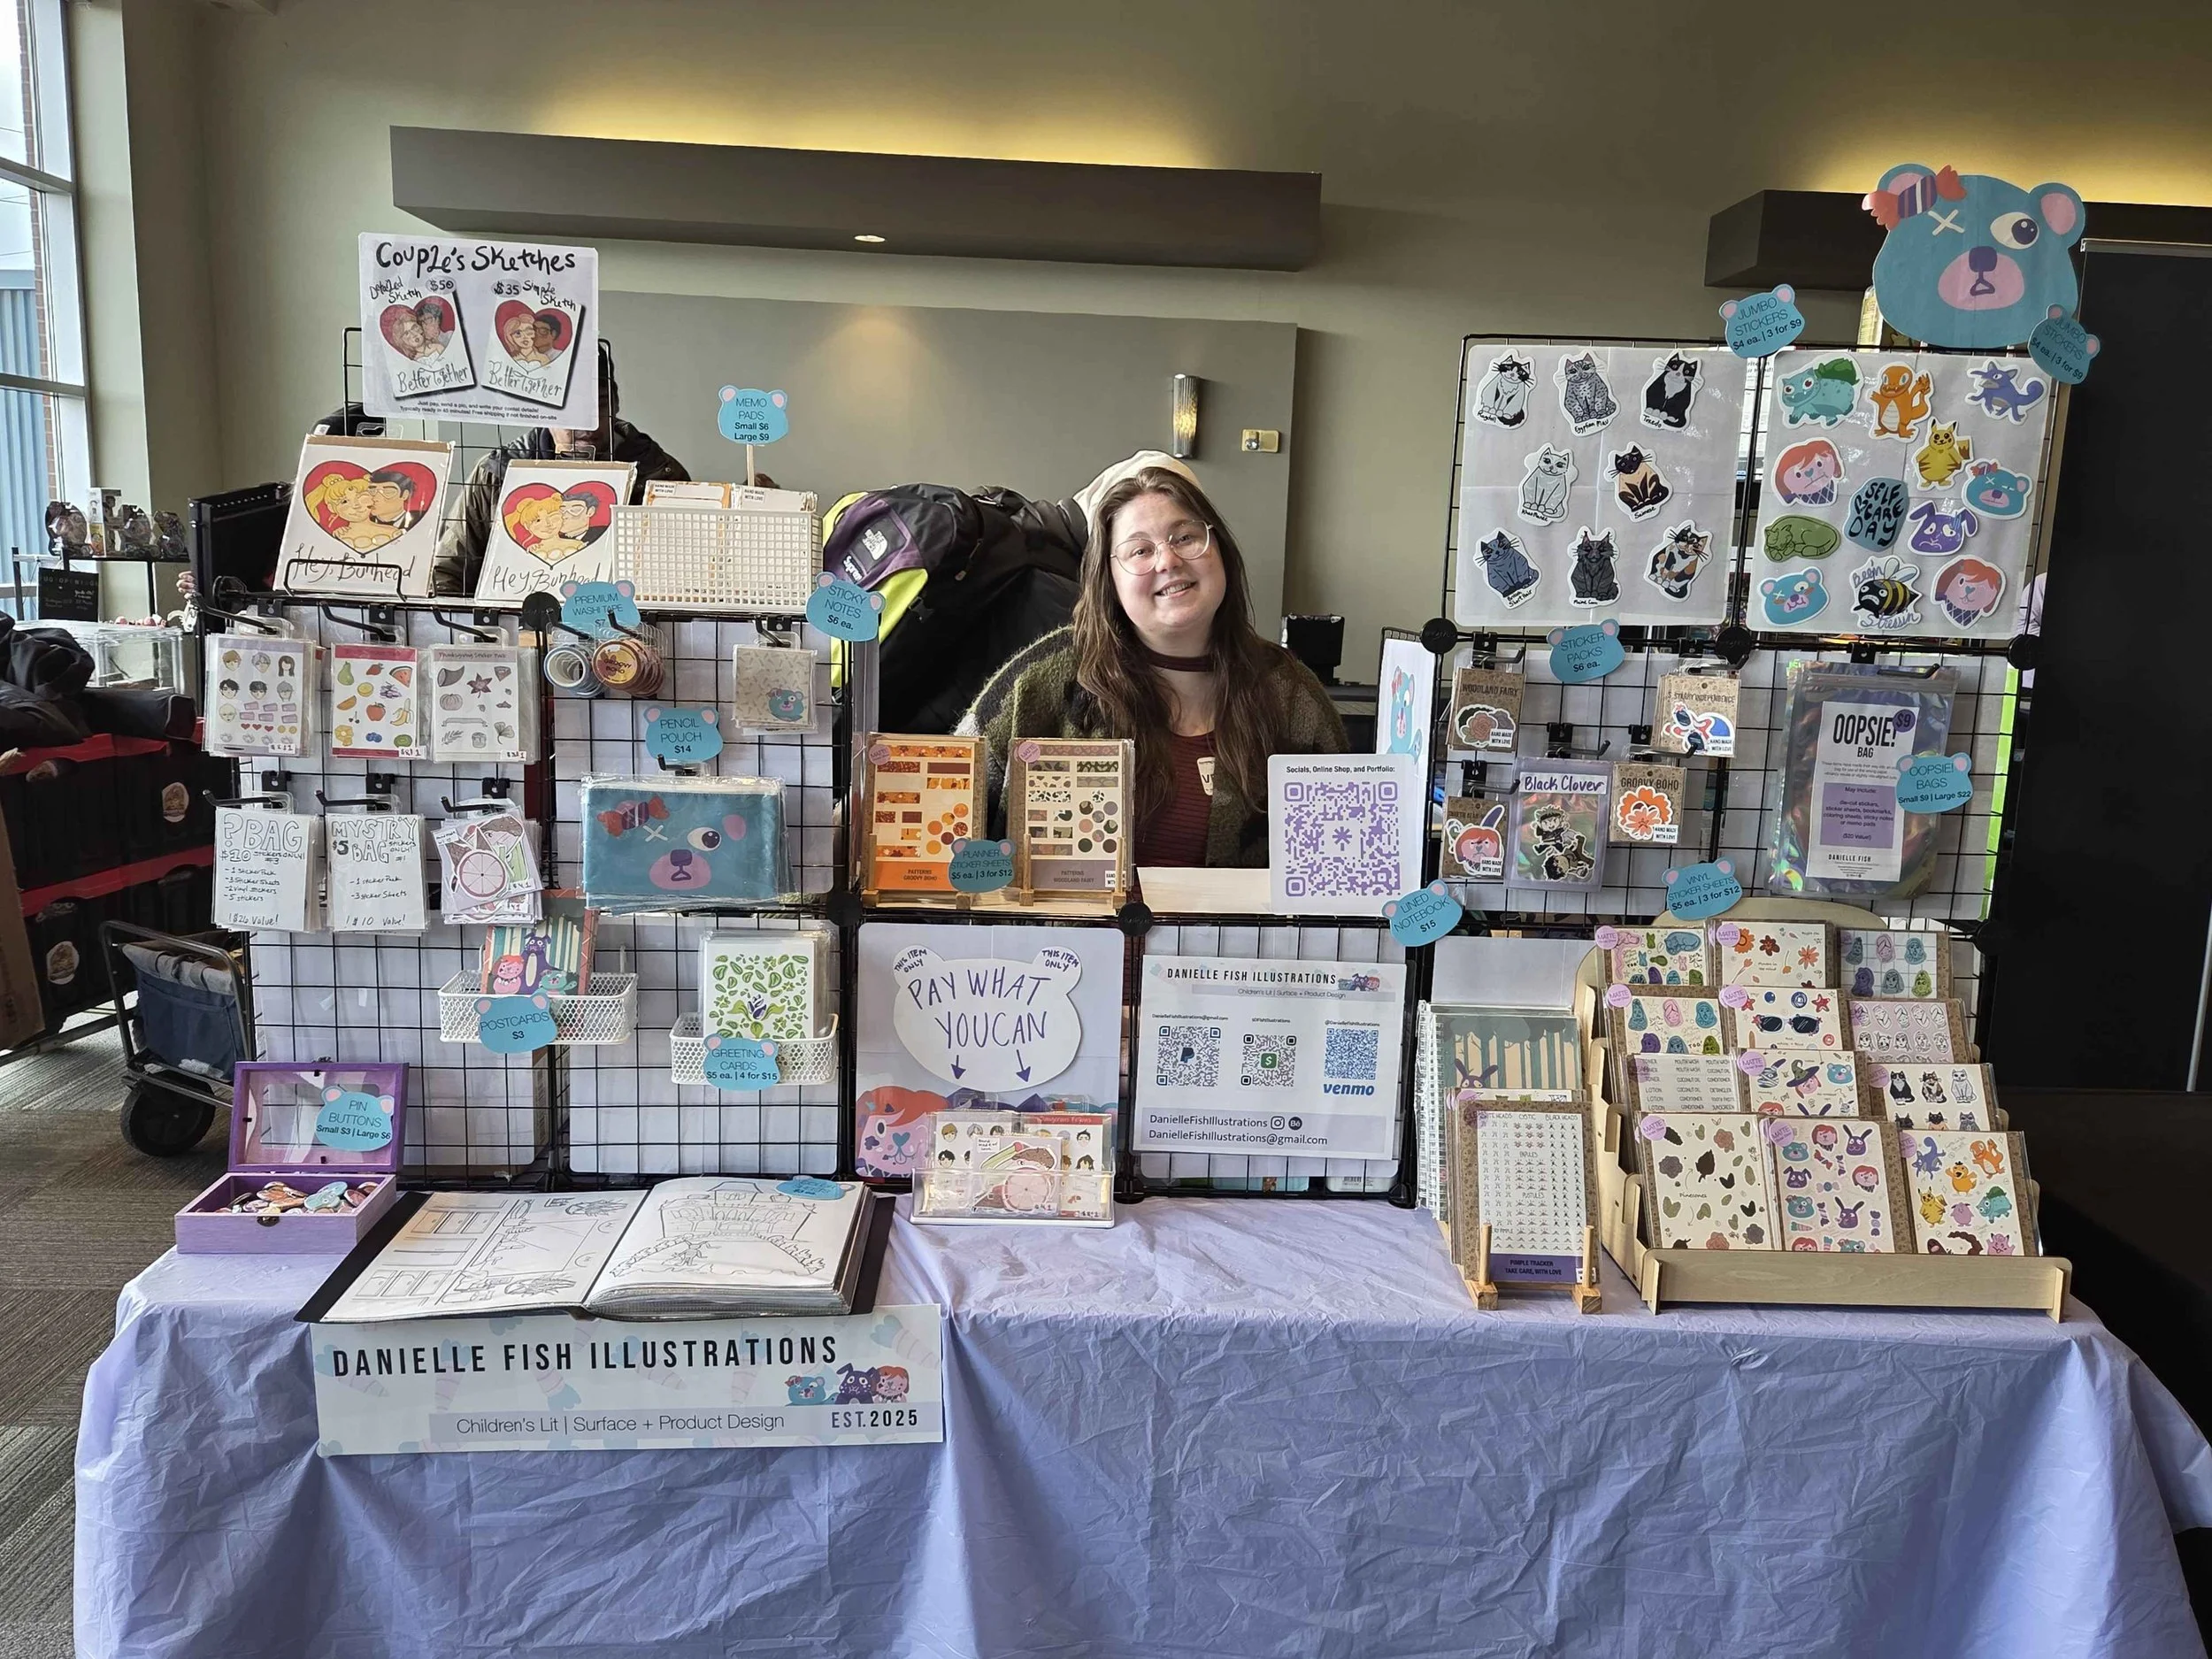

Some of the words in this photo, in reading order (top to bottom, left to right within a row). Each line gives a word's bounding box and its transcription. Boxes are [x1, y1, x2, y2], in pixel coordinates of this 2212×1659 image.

[376, 242, 465, 278] Couple's
[472, 246, 575, 275] Sketches
[429, 280, 454, 291] $50
[493, 281, 519, 295] $35
[522, 280, 556, 296] Simple
[388, 290, 422, 303] Sketch
[541, 295, 576, 311] Sketch
[1738, 297, 1777, 319] JUMBO
[1735, 310, 1787, 336] STICKERS
[1733, 341, 1744, 350] $4
[1747, 336, 1760, 345] ea.
[1775, 325, 1787, 334] for
[1790, 319, 1801, 328] $9
[2044, 325, 2082, 360] STICKERS
[2031, 337, 2040, 348] $4
[2062, 361, 2072, 372] for
[2072, 369, 2083, 380] $9
[736, 398, 767, 407] MEMO
[739, 411, 764, 419] PADS
[1865, 482, 1901, 506] SELF
[1848, 516, 1898, 547] DAY
[338, 551, 415, 580] Bunhead
[494, 564, 531, 593] Hey,
[574, 594, 618, 604] PREMIUM
[828, 586, 867, 605] STICKY
[573, 606, 600, 616] WASHI
[825, 599, 861, 618] NOTES
[827, 615, 839, 625] $6
[841, 620, 854, 630] ea.
[1561, 632, 1605, 651] STICKER
[1567, 646, 1602, 664] PACKS
[1573, 663, 1584, 672] $6
[1462, 684, 1499, 695] WOODLAND
[660, 718, 700, 728] PENCIL
[1896, 712, 1911, 727] $9
[661, 732, 702, 743] POUCH
[1833, 713, 1896, 747] OOPSIE!
[1857, 747, 1874, 758] BAG
[1334, 765, 1352, 774] Shop,
[1909, 763, 1954, 776] OOPSIE!
[1524, 775, 1558, 792] Black
[1561, 774, 1604, 793] Clover
[1656, 780, 1678, 790] BOHO
[1916, 778, 1947, 789] BAGS
[224, 813, 243, 848] ?
[243, 818, 303, 854] BAG
[219, 849, 251, 862] $10
[333, 840, 349, 855] $5
[352, 841, 389, 864] BAG
[963, 849, 999, 858] PLANNER
[1686, 872, 1710, 885] VINYL
[1668, 886, 1701, 902] STICKER
[1702, 876, 1734, 890] SHEETS
[1401, 893, 1429, 913] LINED
[1671, 902, 1682, 910] $5
[1724, 885, 1740, 895] $12
[1394, 897, 1450, 933] NOTEBOOK
[1420, 919, 1436, 933] $15
[894, 956, 908, 972] THIS
[907, 949, 927, 959] ITEM
[903, 958, 924, 973] ONLY
[1041, 949, 1060, 958] THIS
[1060, 950, 1080, 969] ITEM
[1045, 958, 1069, 972] ONLY
[1167, 968, 1218, 980] DANIELLE
[1224, 970, 1248, 981] FISH
[1252, 972, 1336, 984] ILLUSTRATIONS
[907, 972, 956, 1010] PAY
[967, 966, 1051, 1006] WHAT
[1609, 990, 1629, 999] MATTE
[1725, 990, 1746, 999] MATTE
[480, 1011, 549, 1031] POSTCARDS
[512, 1031, 525, 1040] $3
[711, 1048, 764, 1058] GREETING
[720, 1062, 757, 1071] CARDS
[1323, 1083, 1375, 1096] venmo
[349, 1100, 367, 1111] PIN
[329, 1112, 381, 1127] BUTTONS
[1149, 1115, 1268, 1129] DanielleFishIllustrations
[1643, 1120, 1663, 1133] MATTE
[317, 1125, 338, 1133] Small
[357, 1130, 379, 1139] Large
[1148, 1129, 1327, 1146] DanielleFishIllustrations@gmail.com
[1771, 1126, 1790, 1138] MATTE
[333, 1345, 486, 1378] DANIELLE
[503, 1342, 572, 1371] FISH
[590, 1335, 836, 1370] ILLUSTRATIONS
[456, 1417, 535, 1435] Children's
[540, 1417, 559, 1432] Lit
[573, 1417, 637, 1432] Surface
[659, 1414, 723, 1431] Product
[727, 1413, 785, 1433] Design
[831, 1409, 918, 1429] EST.2025
